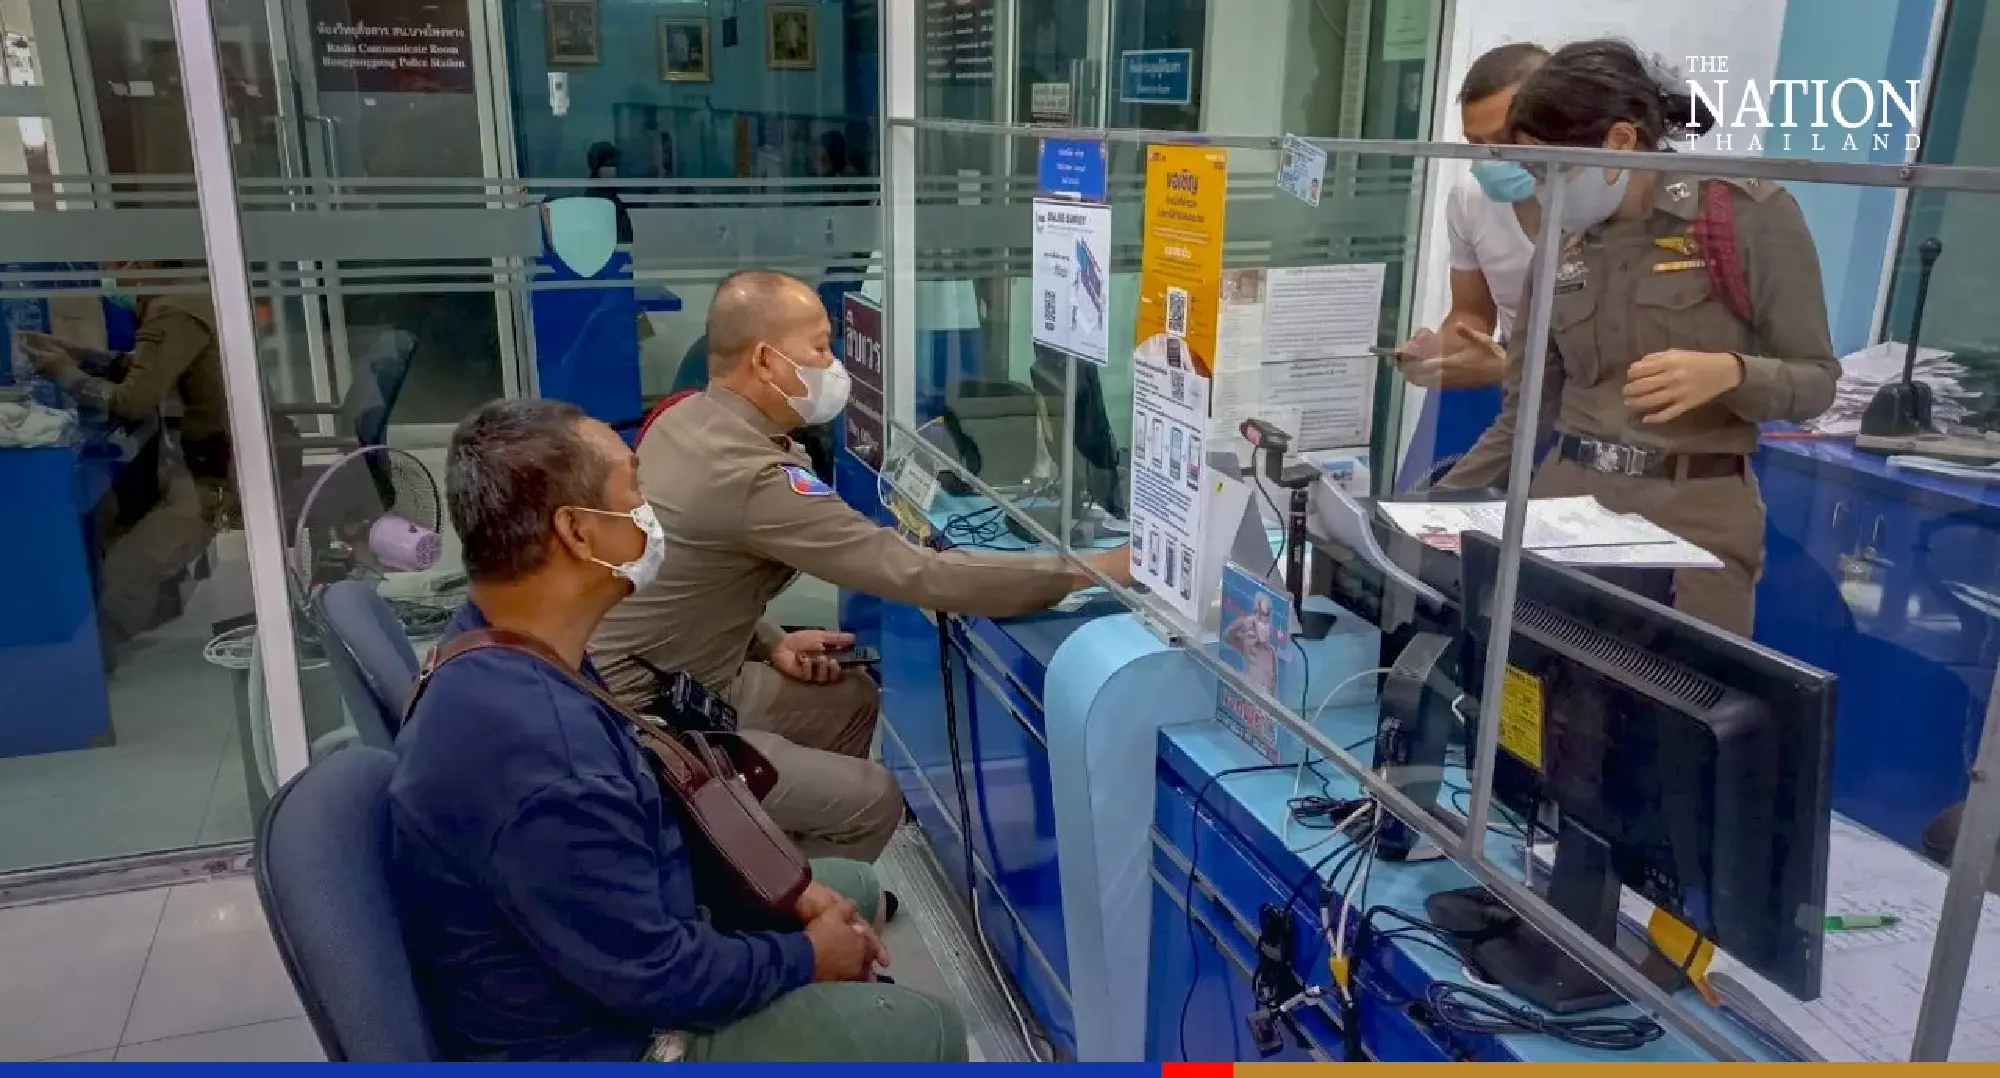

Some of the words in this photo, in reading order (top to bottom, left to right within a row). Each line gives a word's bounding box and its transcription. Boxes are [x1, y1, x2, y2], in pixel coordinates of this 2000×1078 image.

[327, 43, 356, 54] Radio
[429, 43, 459, 54] Room
[399, 57, 427, 68] Police
